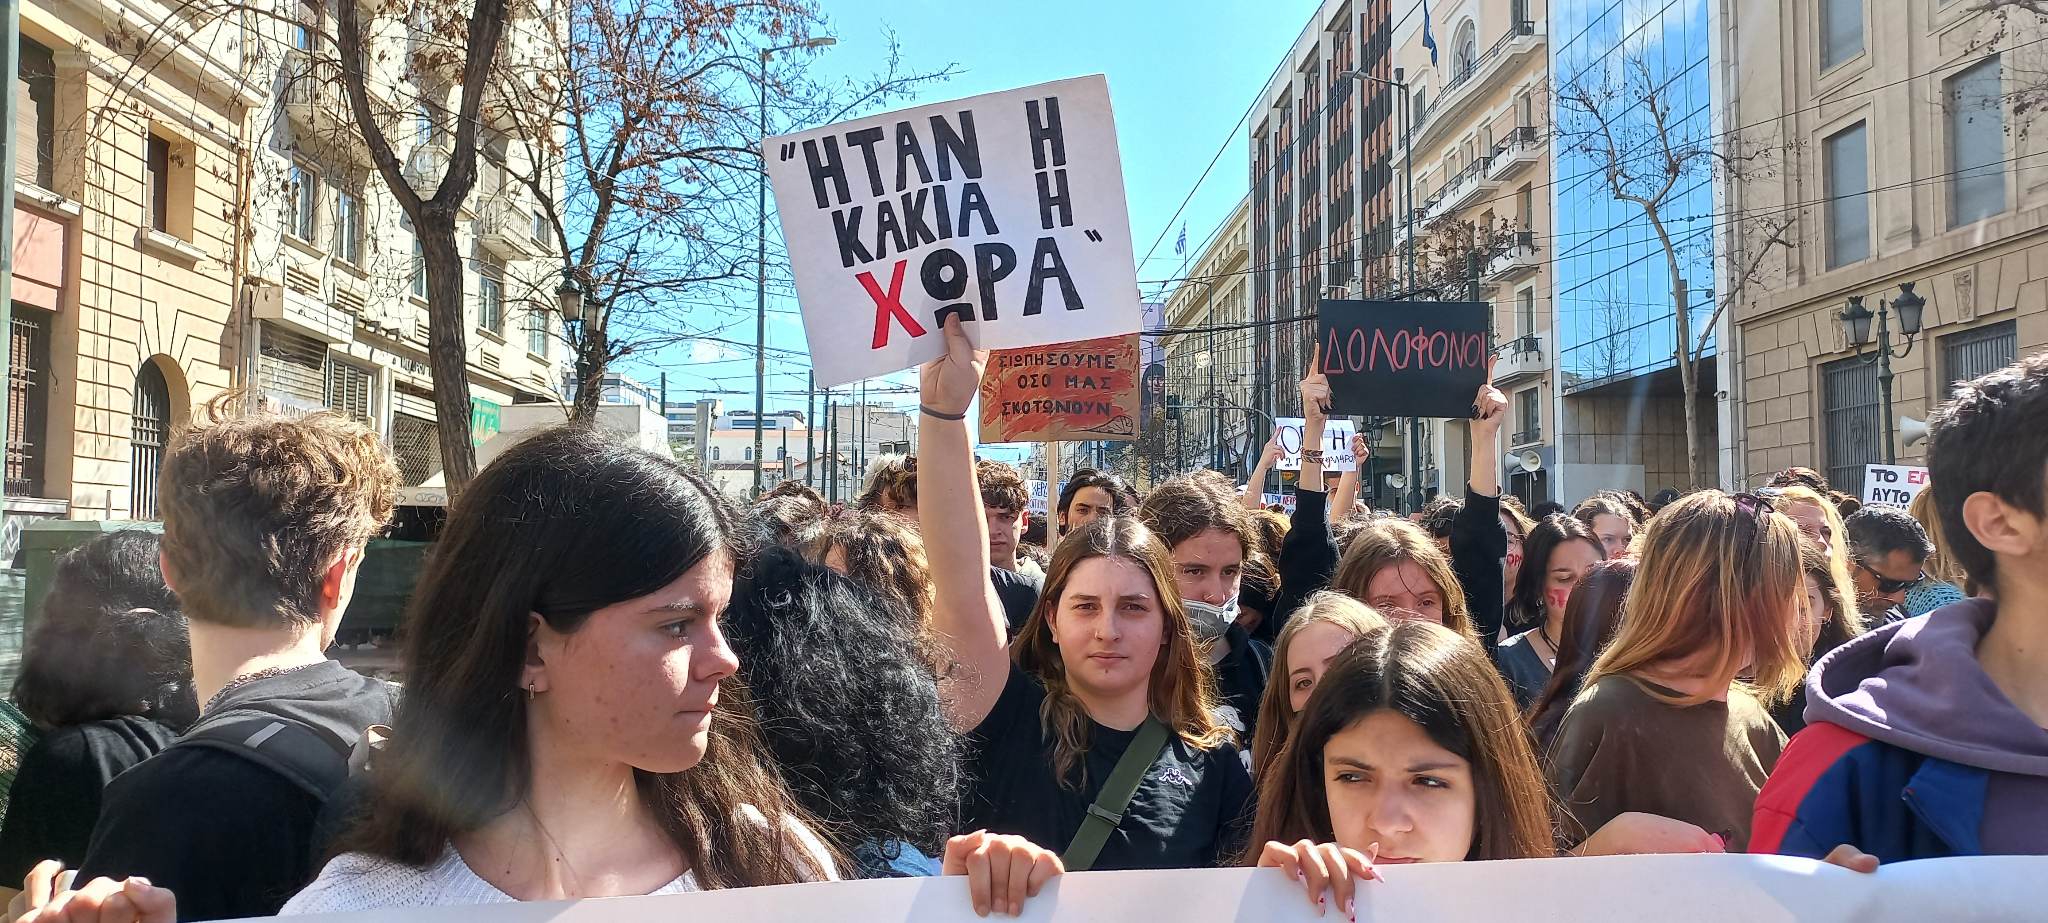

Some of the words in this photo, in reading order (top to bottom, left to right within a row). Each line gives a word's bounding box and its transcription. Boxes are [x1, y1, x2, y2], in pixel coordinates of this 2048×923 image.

[1025, 97, 1067, 169] Η
[832, 182, 999, 268] ΚΑΚΙΑ
[1035, 168, 1074, 229] Η
[1323, 326, 1487, 374] ΔΟΛΟΦΟΝΟΙ
[999, 353, 1116, 369] ΣΙΩΠΗΣΟΥΜΕ
[1018, 373, 1052, 389] ΟΣΟ
[1065, 375, 1112, 390] ΜΑΣ
[1001, 400, 1110, 417] ΣΚΟΤΩΝΟΥΝ
[1871, 469, 1898, 482] ΤΟ
[1872, 488, 1910, 503] ΑΥΤΟ
